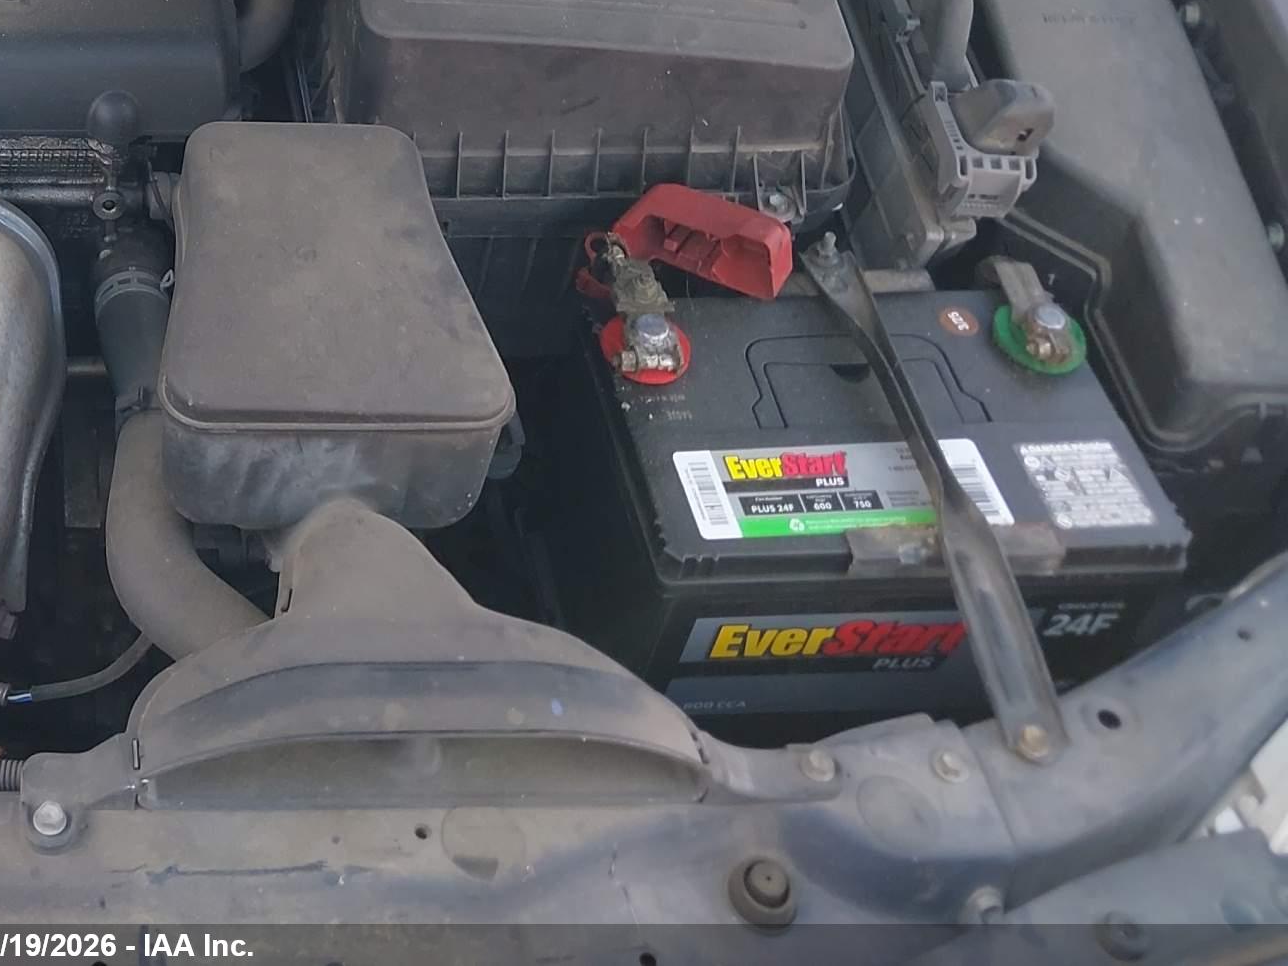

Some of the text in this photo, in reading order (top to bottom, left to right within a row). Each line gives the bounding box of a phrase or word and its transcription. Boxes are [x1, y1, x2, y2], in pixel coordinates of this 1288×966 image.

[724, 451, 847, 480] EverStart
[815, 477, 844, 488] PLUS
[752, 504, 773, 514] PLUS
[1043, 613, 1118, 635] 24F
[709, 620, 968, 659] EverStart
[872, 657, 935, 670] PLUS
